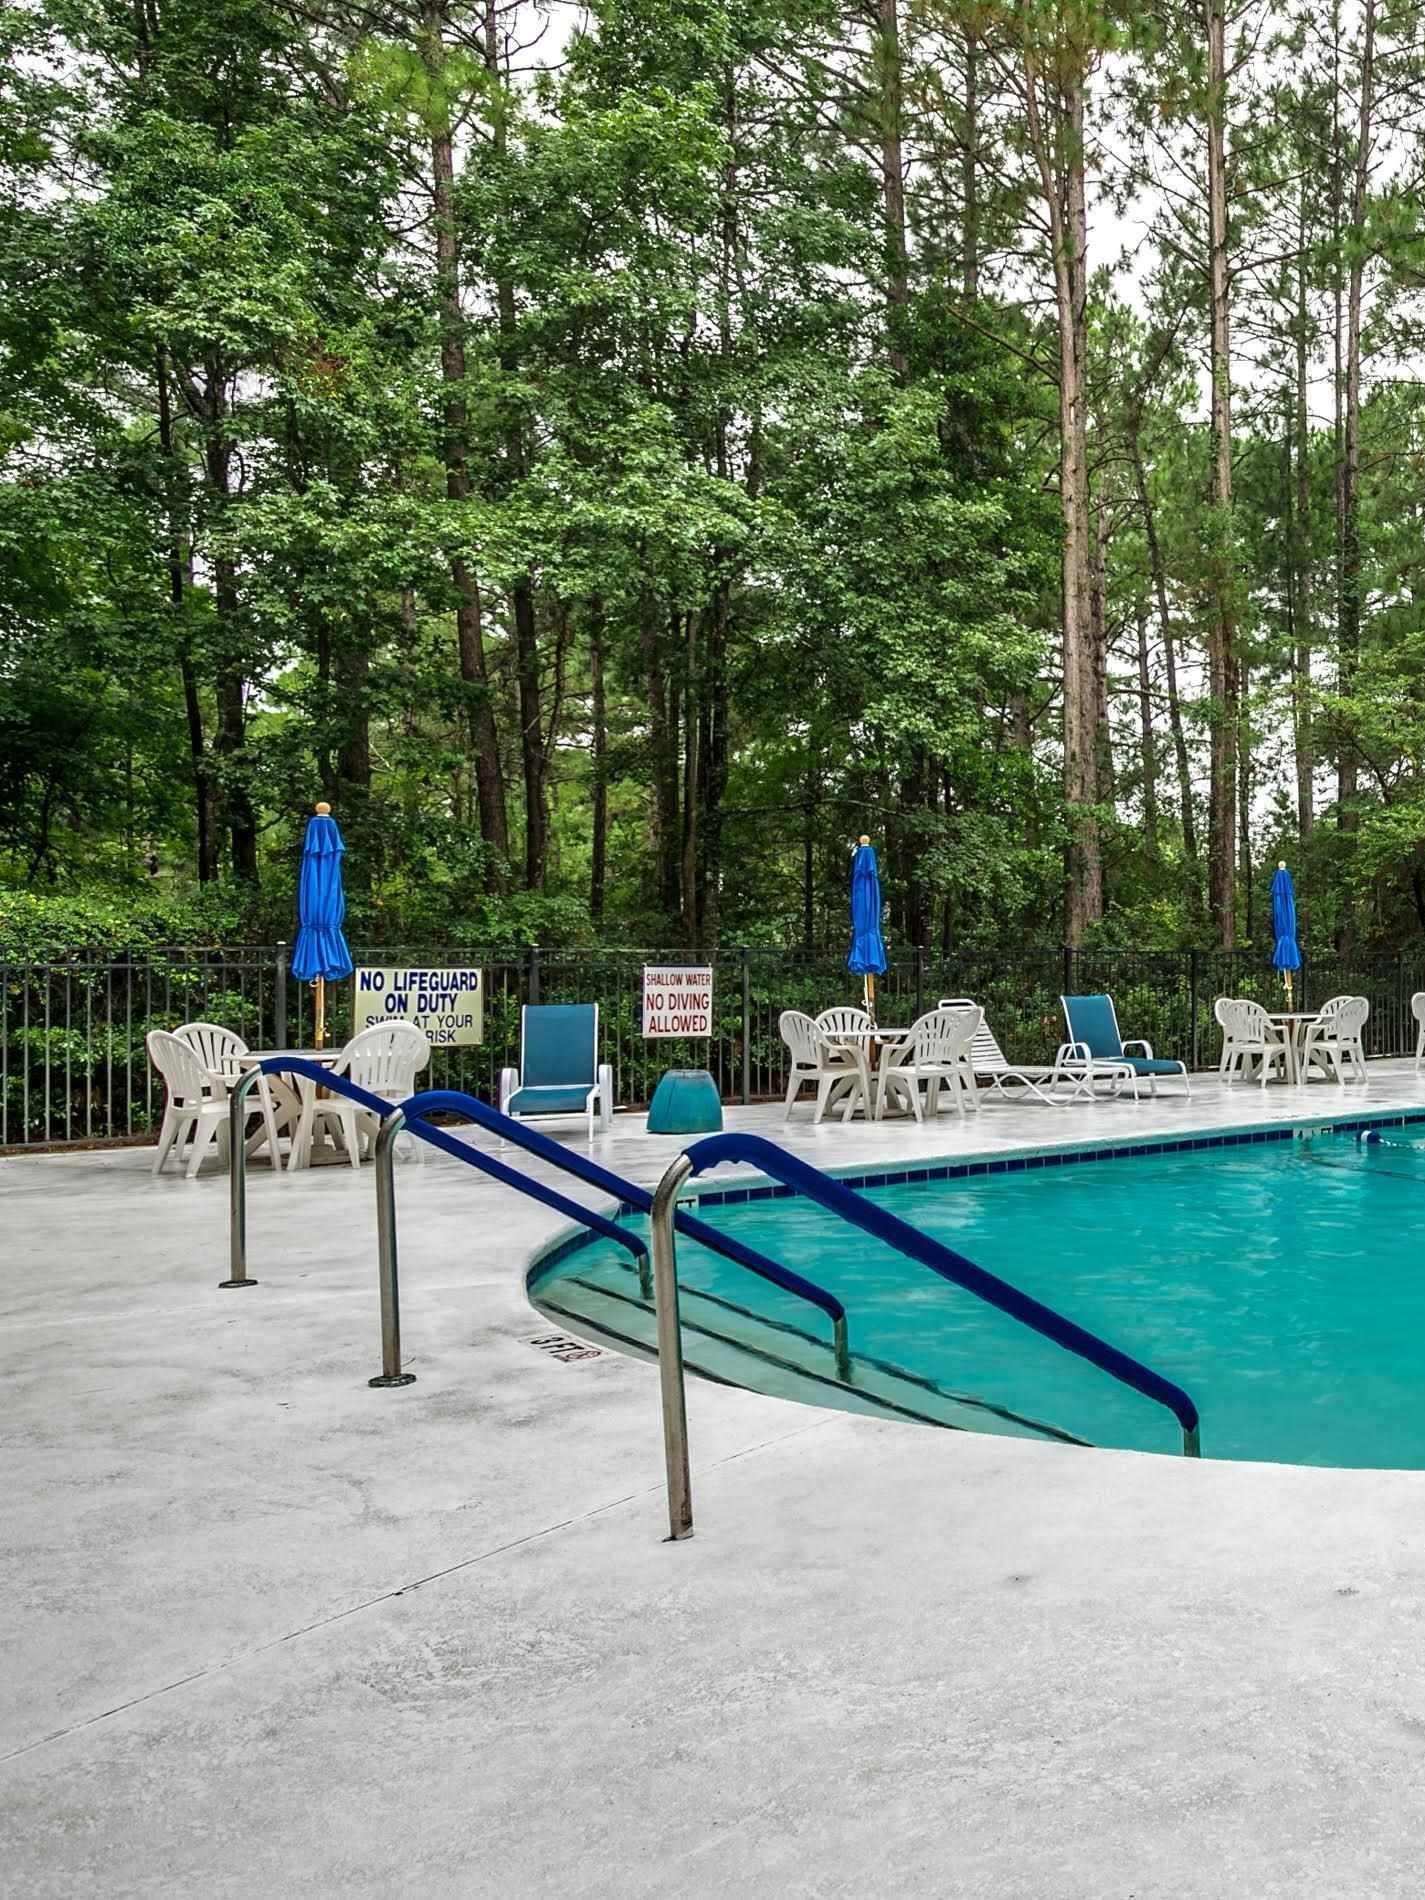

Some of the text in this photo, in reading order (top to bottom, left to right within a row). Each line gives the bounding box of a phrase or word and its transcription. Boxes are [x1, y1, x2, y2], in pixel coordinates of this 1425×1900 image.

[360, 971, 478, 991] NO LIFEGUARD
[646, 973, 711, 986] SHALLOW WATER
[384, 993, 458, 1013] ON DUTY
[646, 993, 710, 1011] NO DIVING
[437, 1014, 473, 1029] YOUR
[648, 1015, 708, 1033] ALLOWED
[530, 1337, 585, 1354] 3 FT
